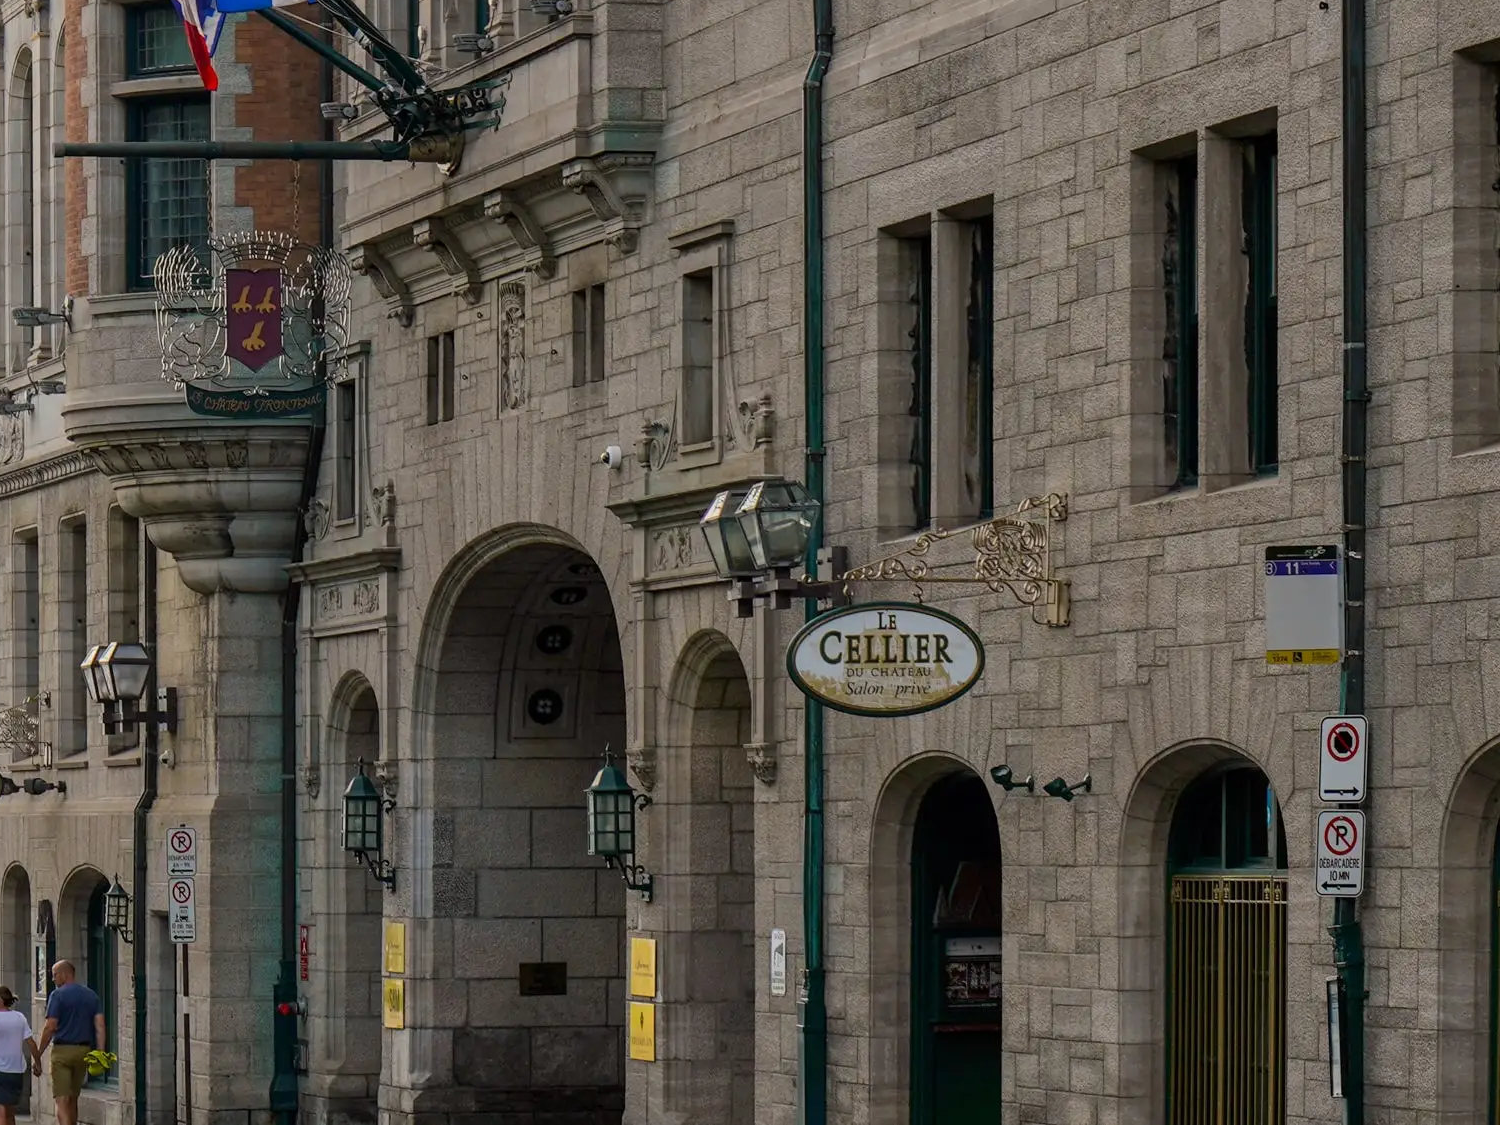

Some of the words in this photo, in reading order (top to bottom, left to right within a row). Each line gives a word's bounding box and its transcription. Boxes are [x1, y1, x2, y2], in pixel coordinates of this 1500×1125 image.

[1285, 562, 1299, 575] 11
[877, 612, 897, 630] LE
[819, 631, 953, 664] CELLIER
[846, 667, 866, 677] DU
[845, 681, 884, 696] Salon
[1319, 857, 1360, 869] DÉBARCADÈRE
[1329, 870, 1338, 881] 10
[1338, 870, 1350, 880] MIN
